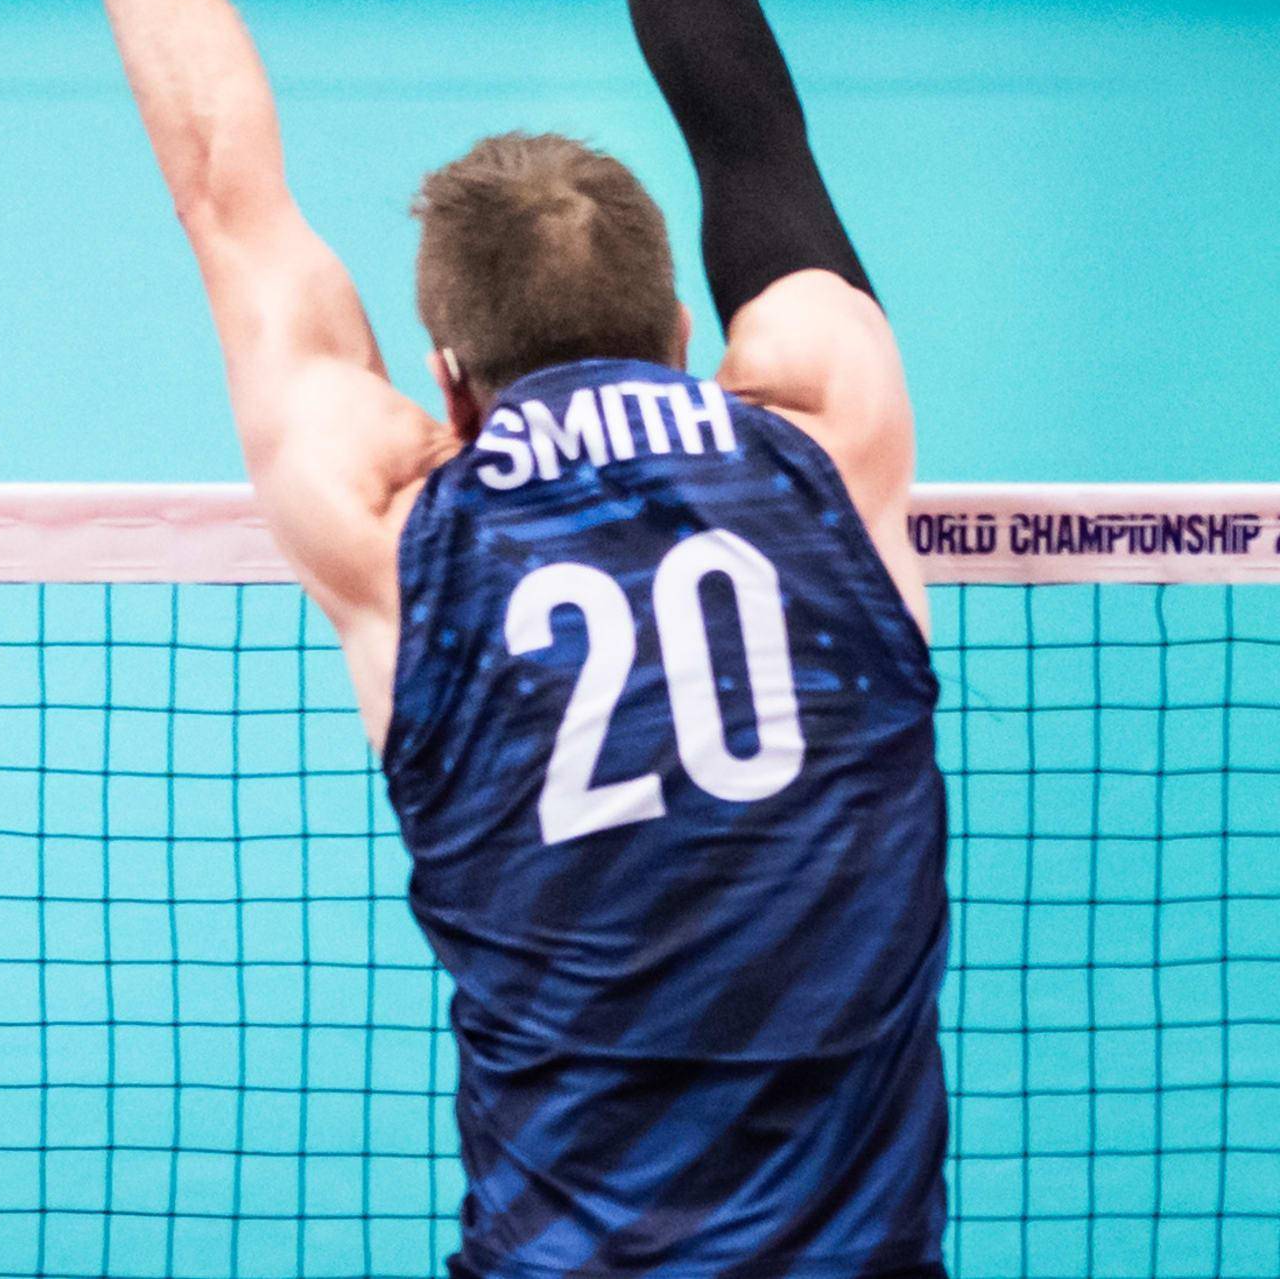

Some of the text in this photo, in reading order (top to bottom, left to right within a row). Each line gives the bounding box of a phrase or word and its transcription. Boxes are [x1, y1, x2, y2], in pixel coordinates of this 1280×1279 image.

[476, 380, 737, 491] SMITH
[907, 514, 996, 554] ORLD
[1010, 514, 1262, 554] CHAMPIONSHIP
[504, 528, 806, 846] 20
